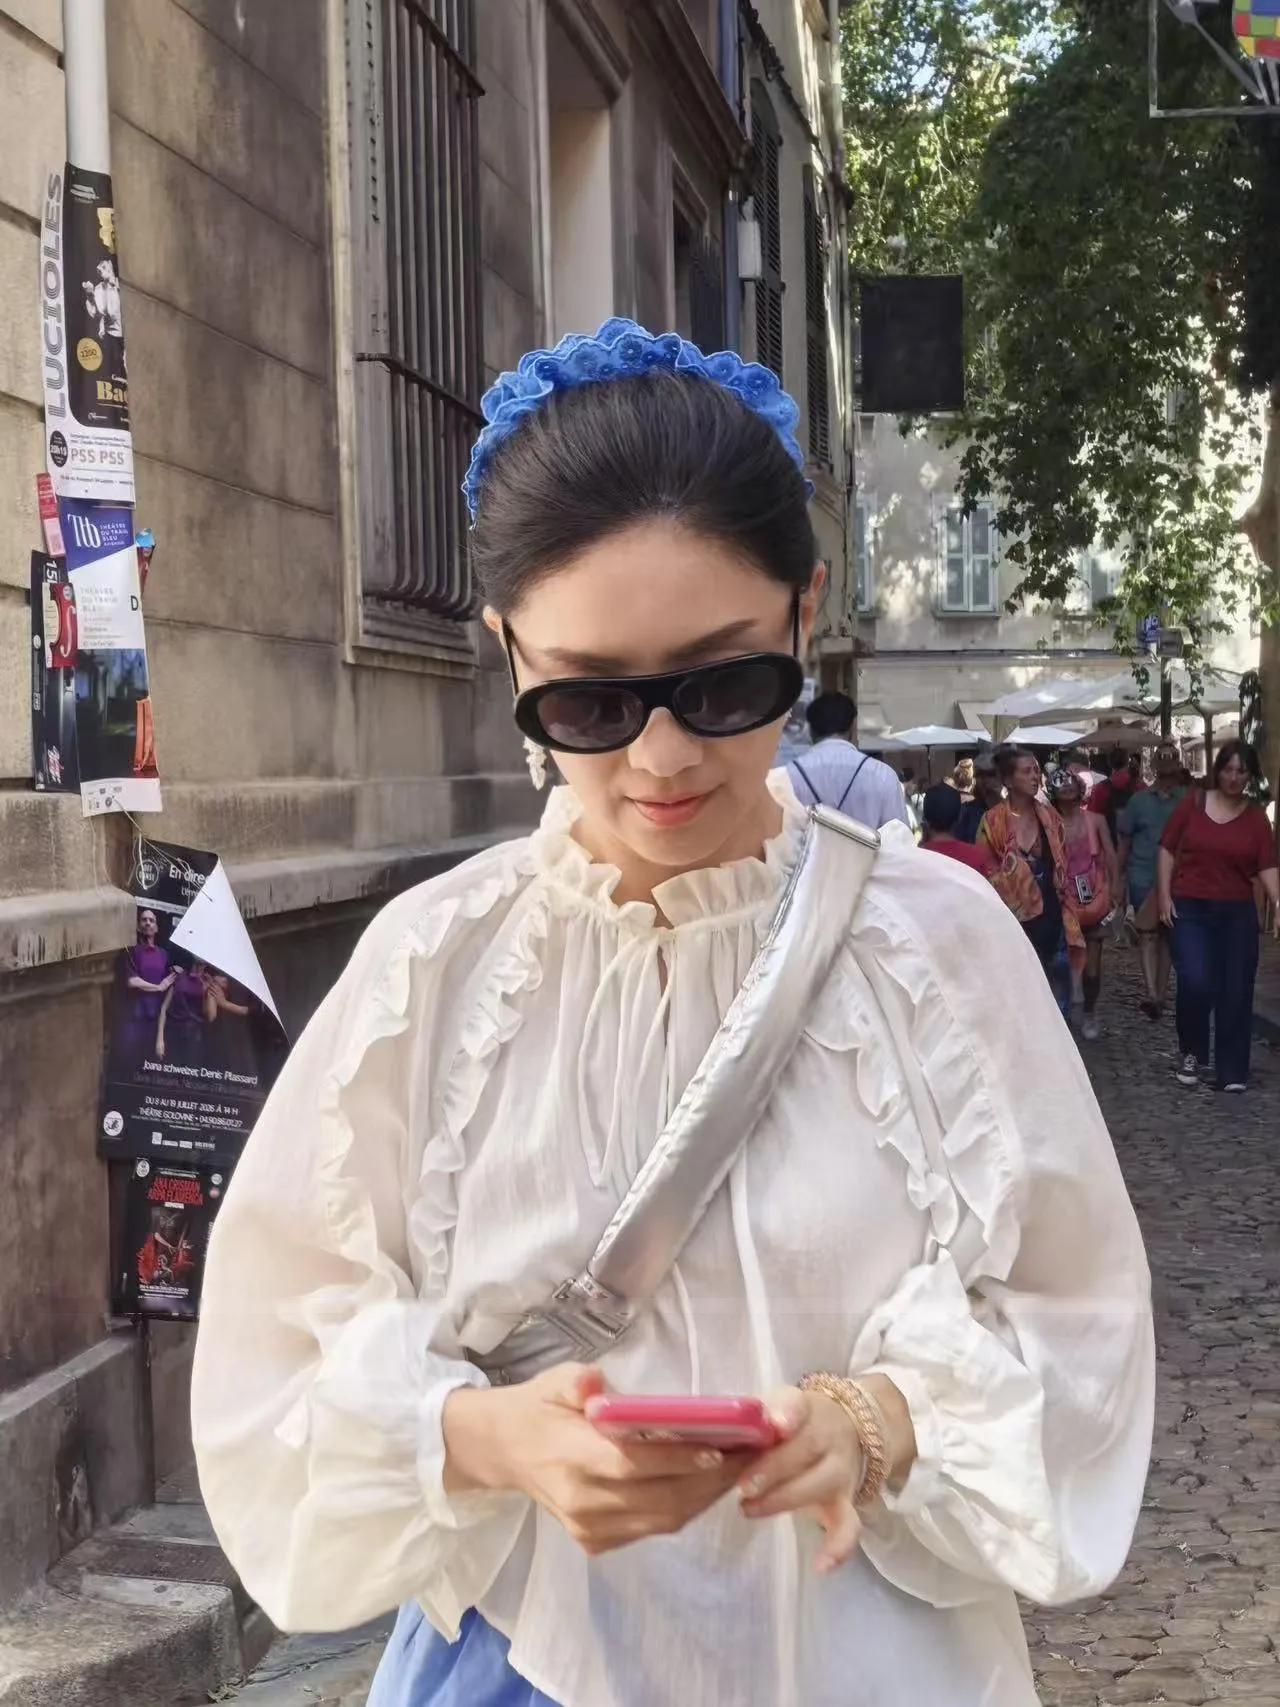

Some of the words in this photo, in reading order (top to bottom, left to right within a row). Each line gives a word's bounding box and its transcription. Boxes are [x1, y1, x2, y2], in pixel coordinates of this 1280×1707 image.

[43, 173, 67, 418] LUCIOLES
[71, 448, 95, 464] PSS
[100, 450, 125, 466] PSS
[200, 1068, 223, 1080] Denis
[224, 1071, 258, 1085] Plassard
[178, 1100, 199, 1110] JUILLET
